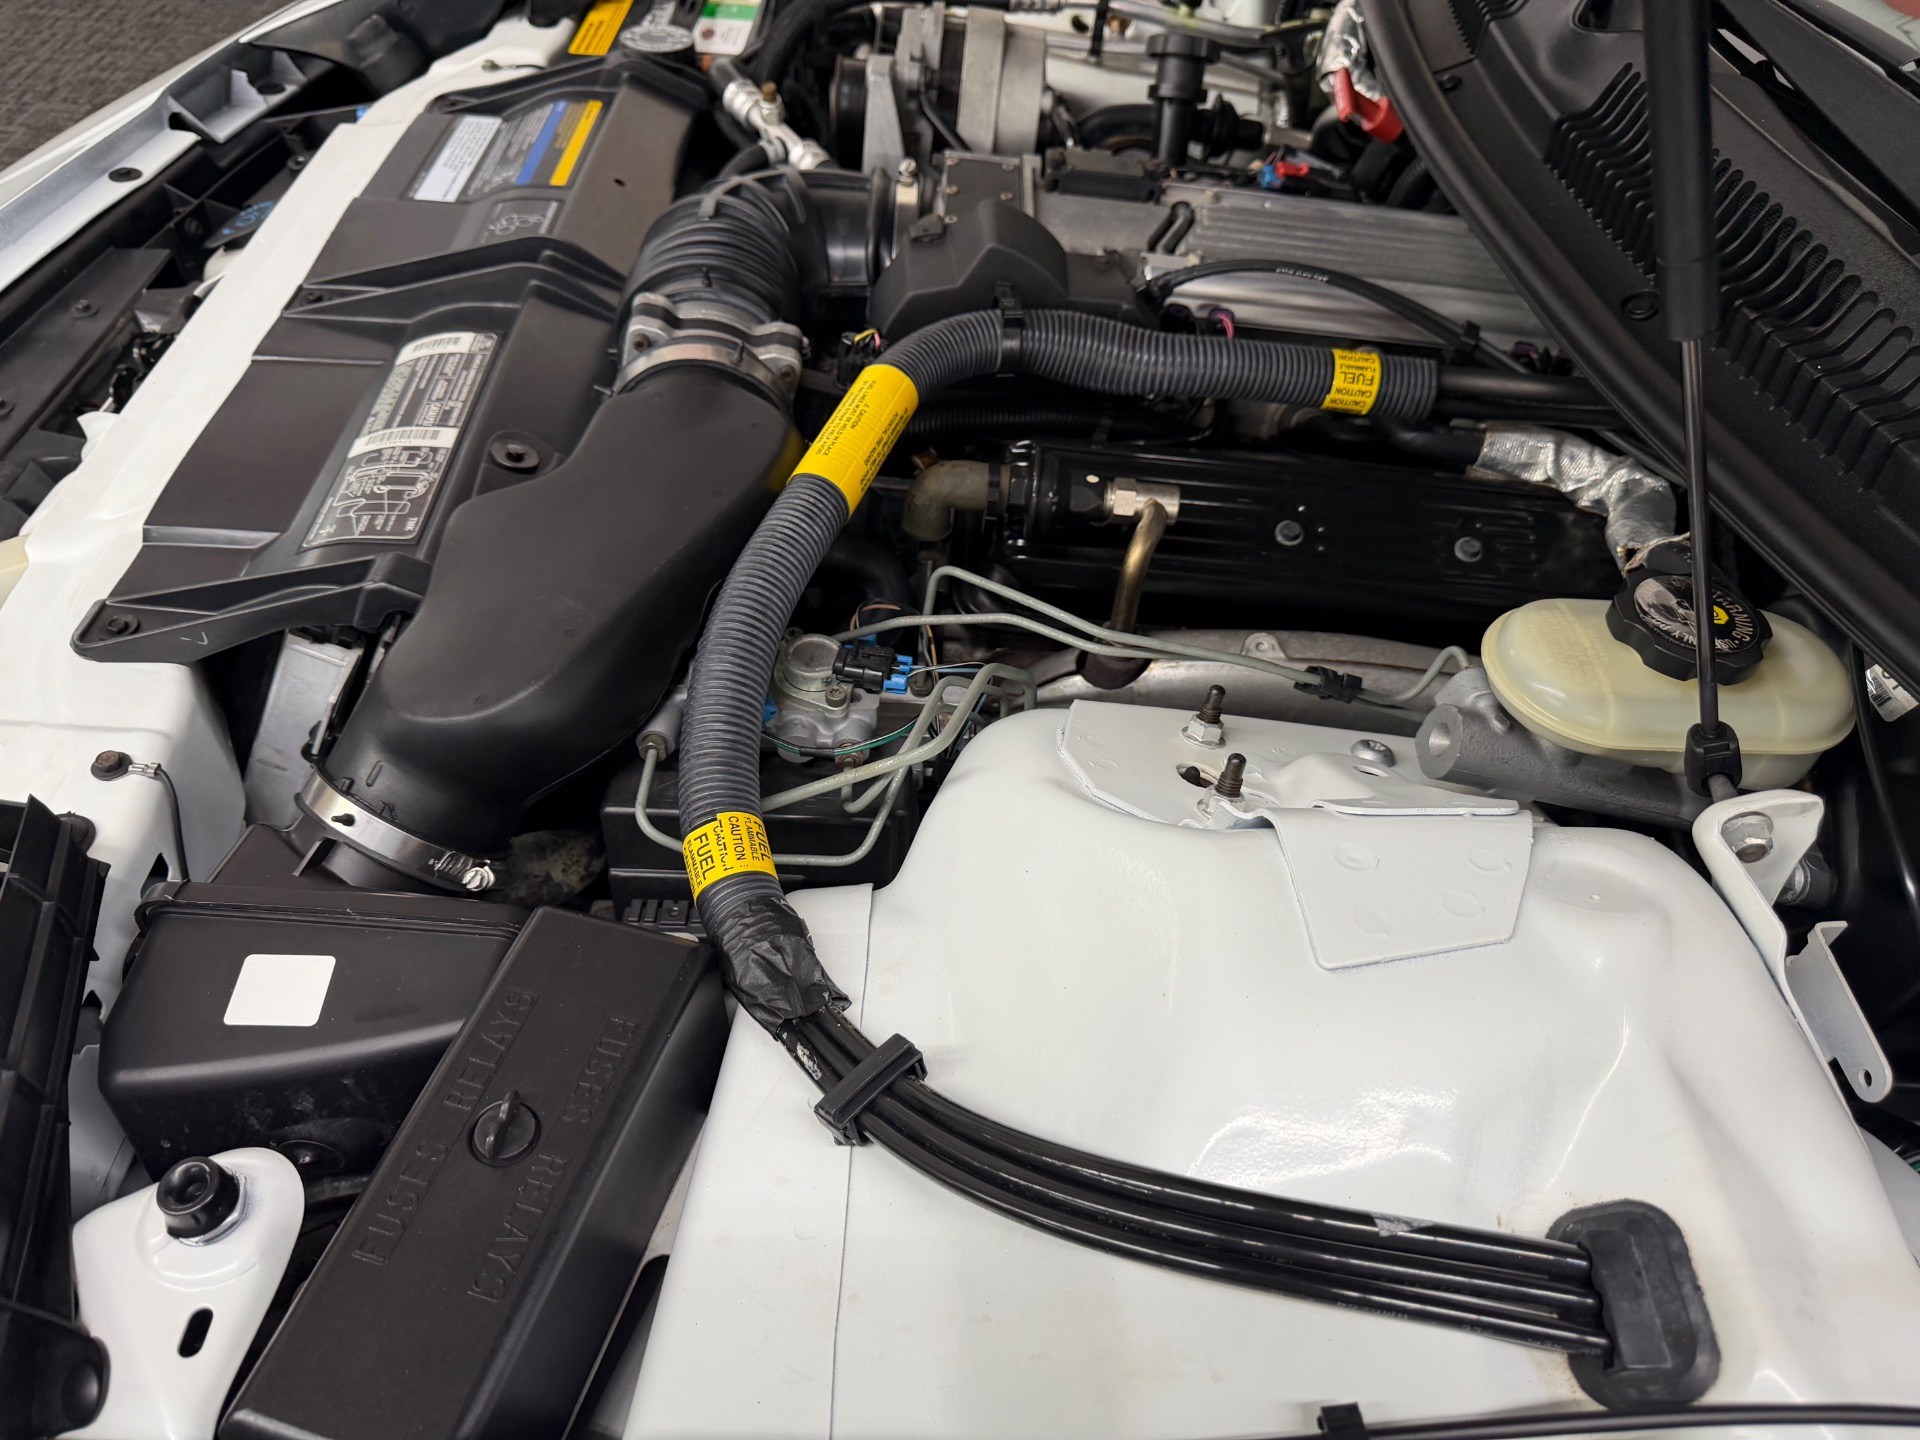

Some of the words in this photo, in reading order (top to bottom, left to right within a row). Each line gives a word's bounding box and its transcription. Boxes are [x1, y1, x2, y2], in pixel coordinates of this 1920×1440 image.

[1334, 388, 1372, 398] CAUTION
[1339, 371, 1374, 386] FUEL
[850, 409, 866, 429] CAUTION
[1329, 398, 1366, 408] CAUTION
[1713, 590, 1753, 642] ARNING
[694, 831, 716, 881] FUEL
[728, 815, 747, 861] CAUTION
[744, 816, 760, 861] FLAMMABLE
[754, 820, 771, 862] FUEL
[686, 839, 702, 887] FLAMMABLE
[560, 1015, 641, 1124] FUSES
[351, 1140, 449, 1266] FUSES
[442, 991, 540, 1111] RELAYS
[467, 1152, 568, 1302] RELAYS
